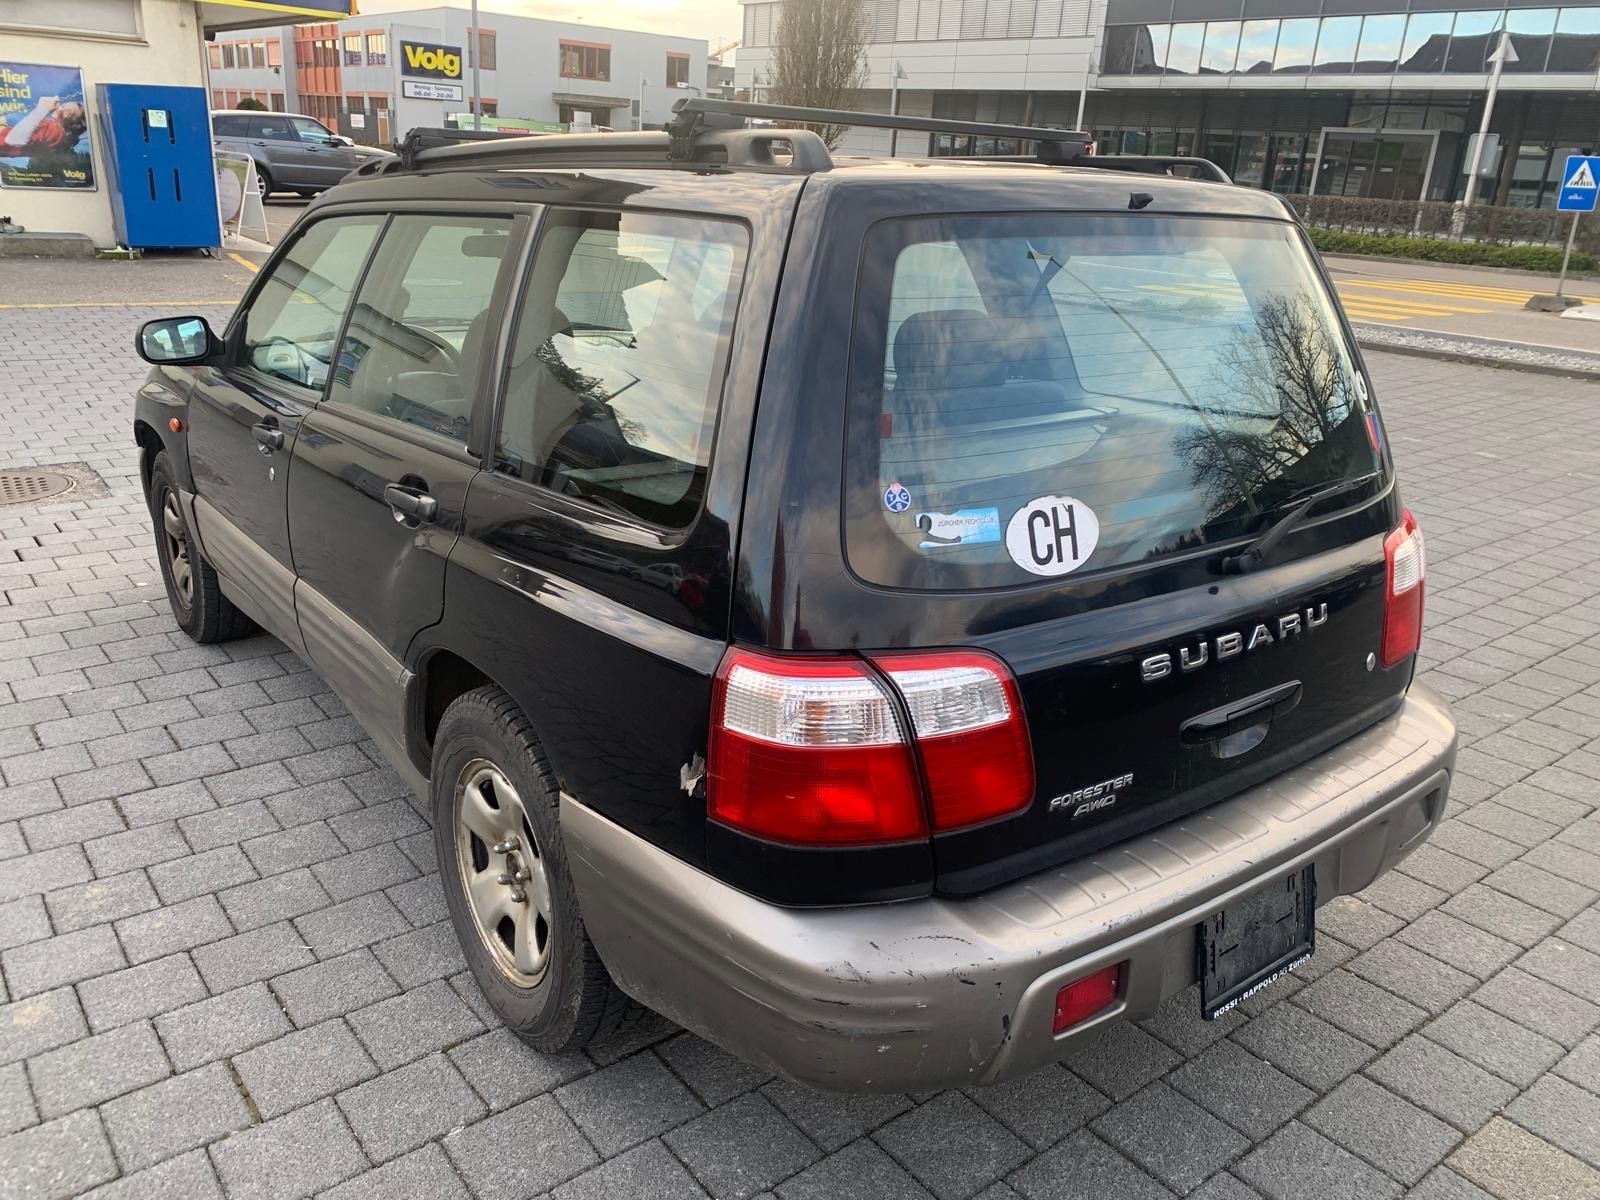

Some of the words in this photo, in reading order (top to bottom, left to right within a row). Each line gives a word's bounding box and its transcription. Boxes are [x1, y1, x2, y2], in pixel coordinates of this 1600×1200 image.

[404, 45, 461, 77] Volg
[0, 84, 31, 99] sind
[63, 169, 86, 180] Volg
[1027, 503, 1079, 566] CH
[1141, 602, 1328, 682] SUBARU
[1049, 773, 1134, 811] FORESTER
[1073, 794, 1116, 817] AWD
[1213, 998, 1238, 1019] ROSSI
[1243, 973, 1279, 1000] RAPPOLD
[1279, 968, 1288, 979] AG
[1288, 954, 1311, 972] Zürich
